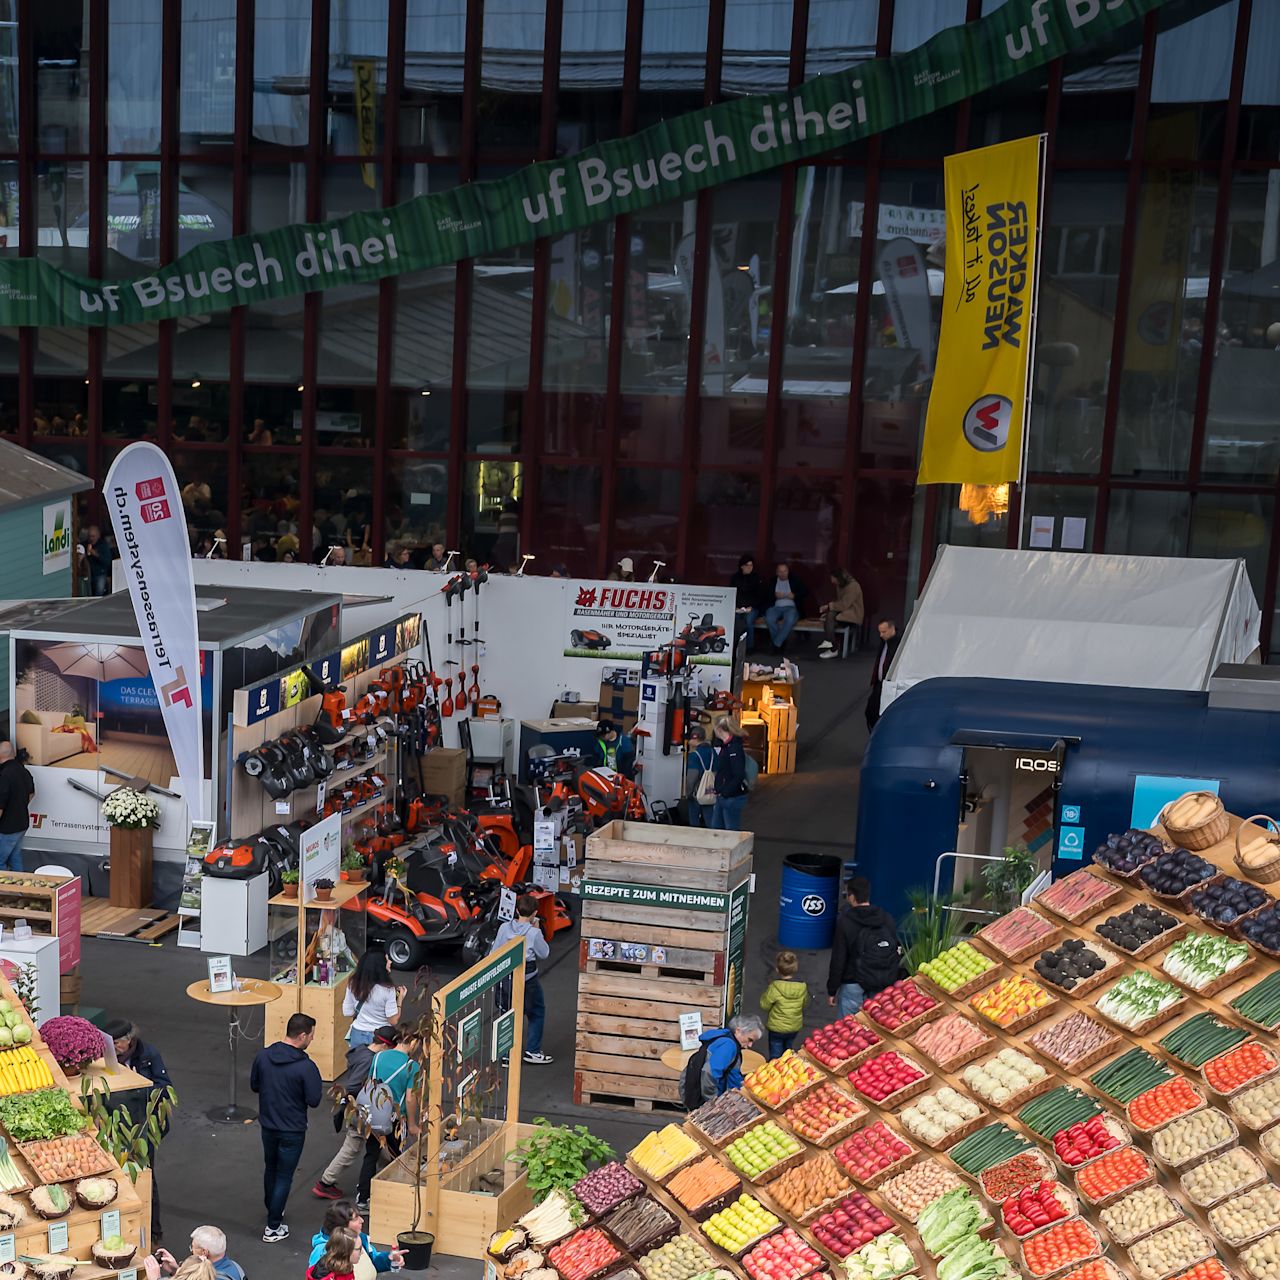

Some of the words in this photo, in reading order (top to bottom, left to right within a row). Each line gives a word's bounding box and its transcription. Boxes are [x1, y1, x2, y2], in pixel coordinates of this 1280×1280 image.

[1006, 7, 1050, 59] uf
[522, 169, 566, 223] uf
[579, 120, 736, 205] Bsuech
[750, 79, 866, 153] dihei
[80, 284, 120, 313] uf
[132, 243, 284, 309] Bsuech
[295, 217, 398, 279] dihei
[44, 528, 69, 555] Landi
[599, 588, 668, 611] FUCHS
[120, 686, 136, 695] DAS
[1015, 758, 1060, 771] IQOS
[51, 820, 109, 832] Terrassensystem.c
[585, 884, 630, 898] REZEPTE
[633, 889, 657, 900] ZUM
[660, 892, 725, 907] MITNEHMEN
